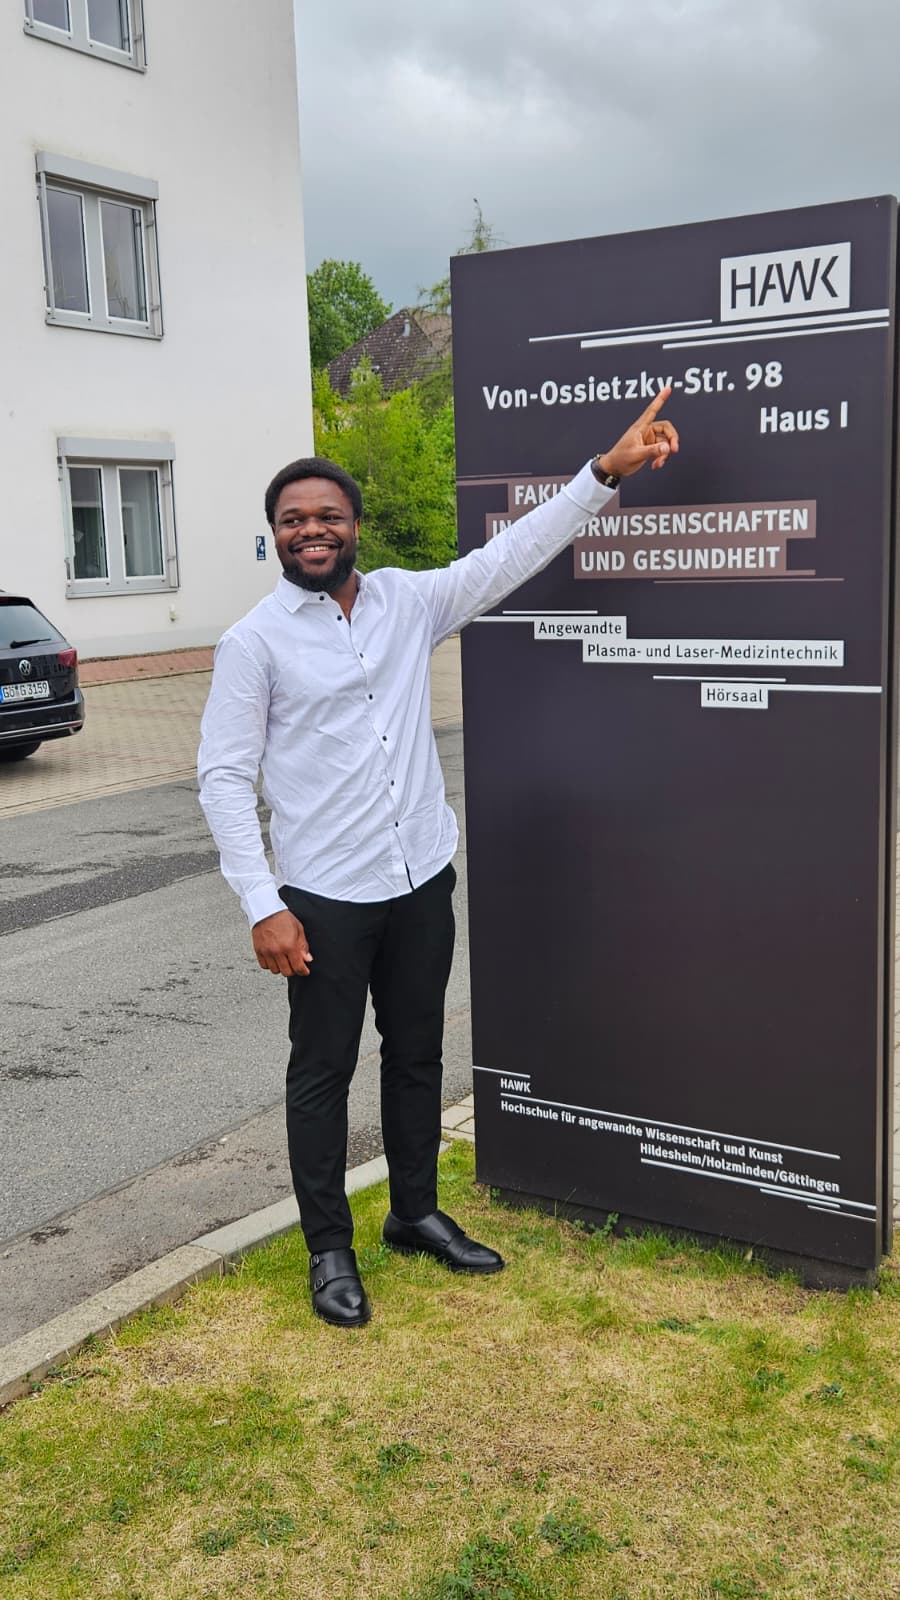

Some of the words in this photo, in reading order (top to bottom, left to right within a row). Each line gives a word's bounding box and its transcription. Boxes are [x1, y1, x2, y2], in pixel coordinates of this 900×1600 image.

[731, 255, 839, 309] HAWK
[482, 367, 735, 410] Von-Ossietzky-Str.
[745, 361, 783, 390] 98
[759, 406, 831, 434] Haus
[581, 551, 625, 571] UND
[633, 547, 780, 571] GESUNDHEIT
[538, 620, 623, 636] Angewandte
[587, 643, 642, 659] Plasma-
[646, 644, 671, 658] und
[676, 644, 838, 661] Laser-Medizintechnik
[706, 688, 763, 703] Hörsaal
[500, 1078, 531, 1093] HAWK
[501, 1101, 559, 1120] Hochschule
[560, 1111, 577, 1125] für
[578, 1117, 643, 1136] angewandte
[645, 1127, 721, 1152] Wissenschaft
[723, 1142, 746, 1157] und
[748, 1146, 784, 1165] Kunst
[640, 1142, 840, 1193] Hildesheim/Holzminden/Göttingen
